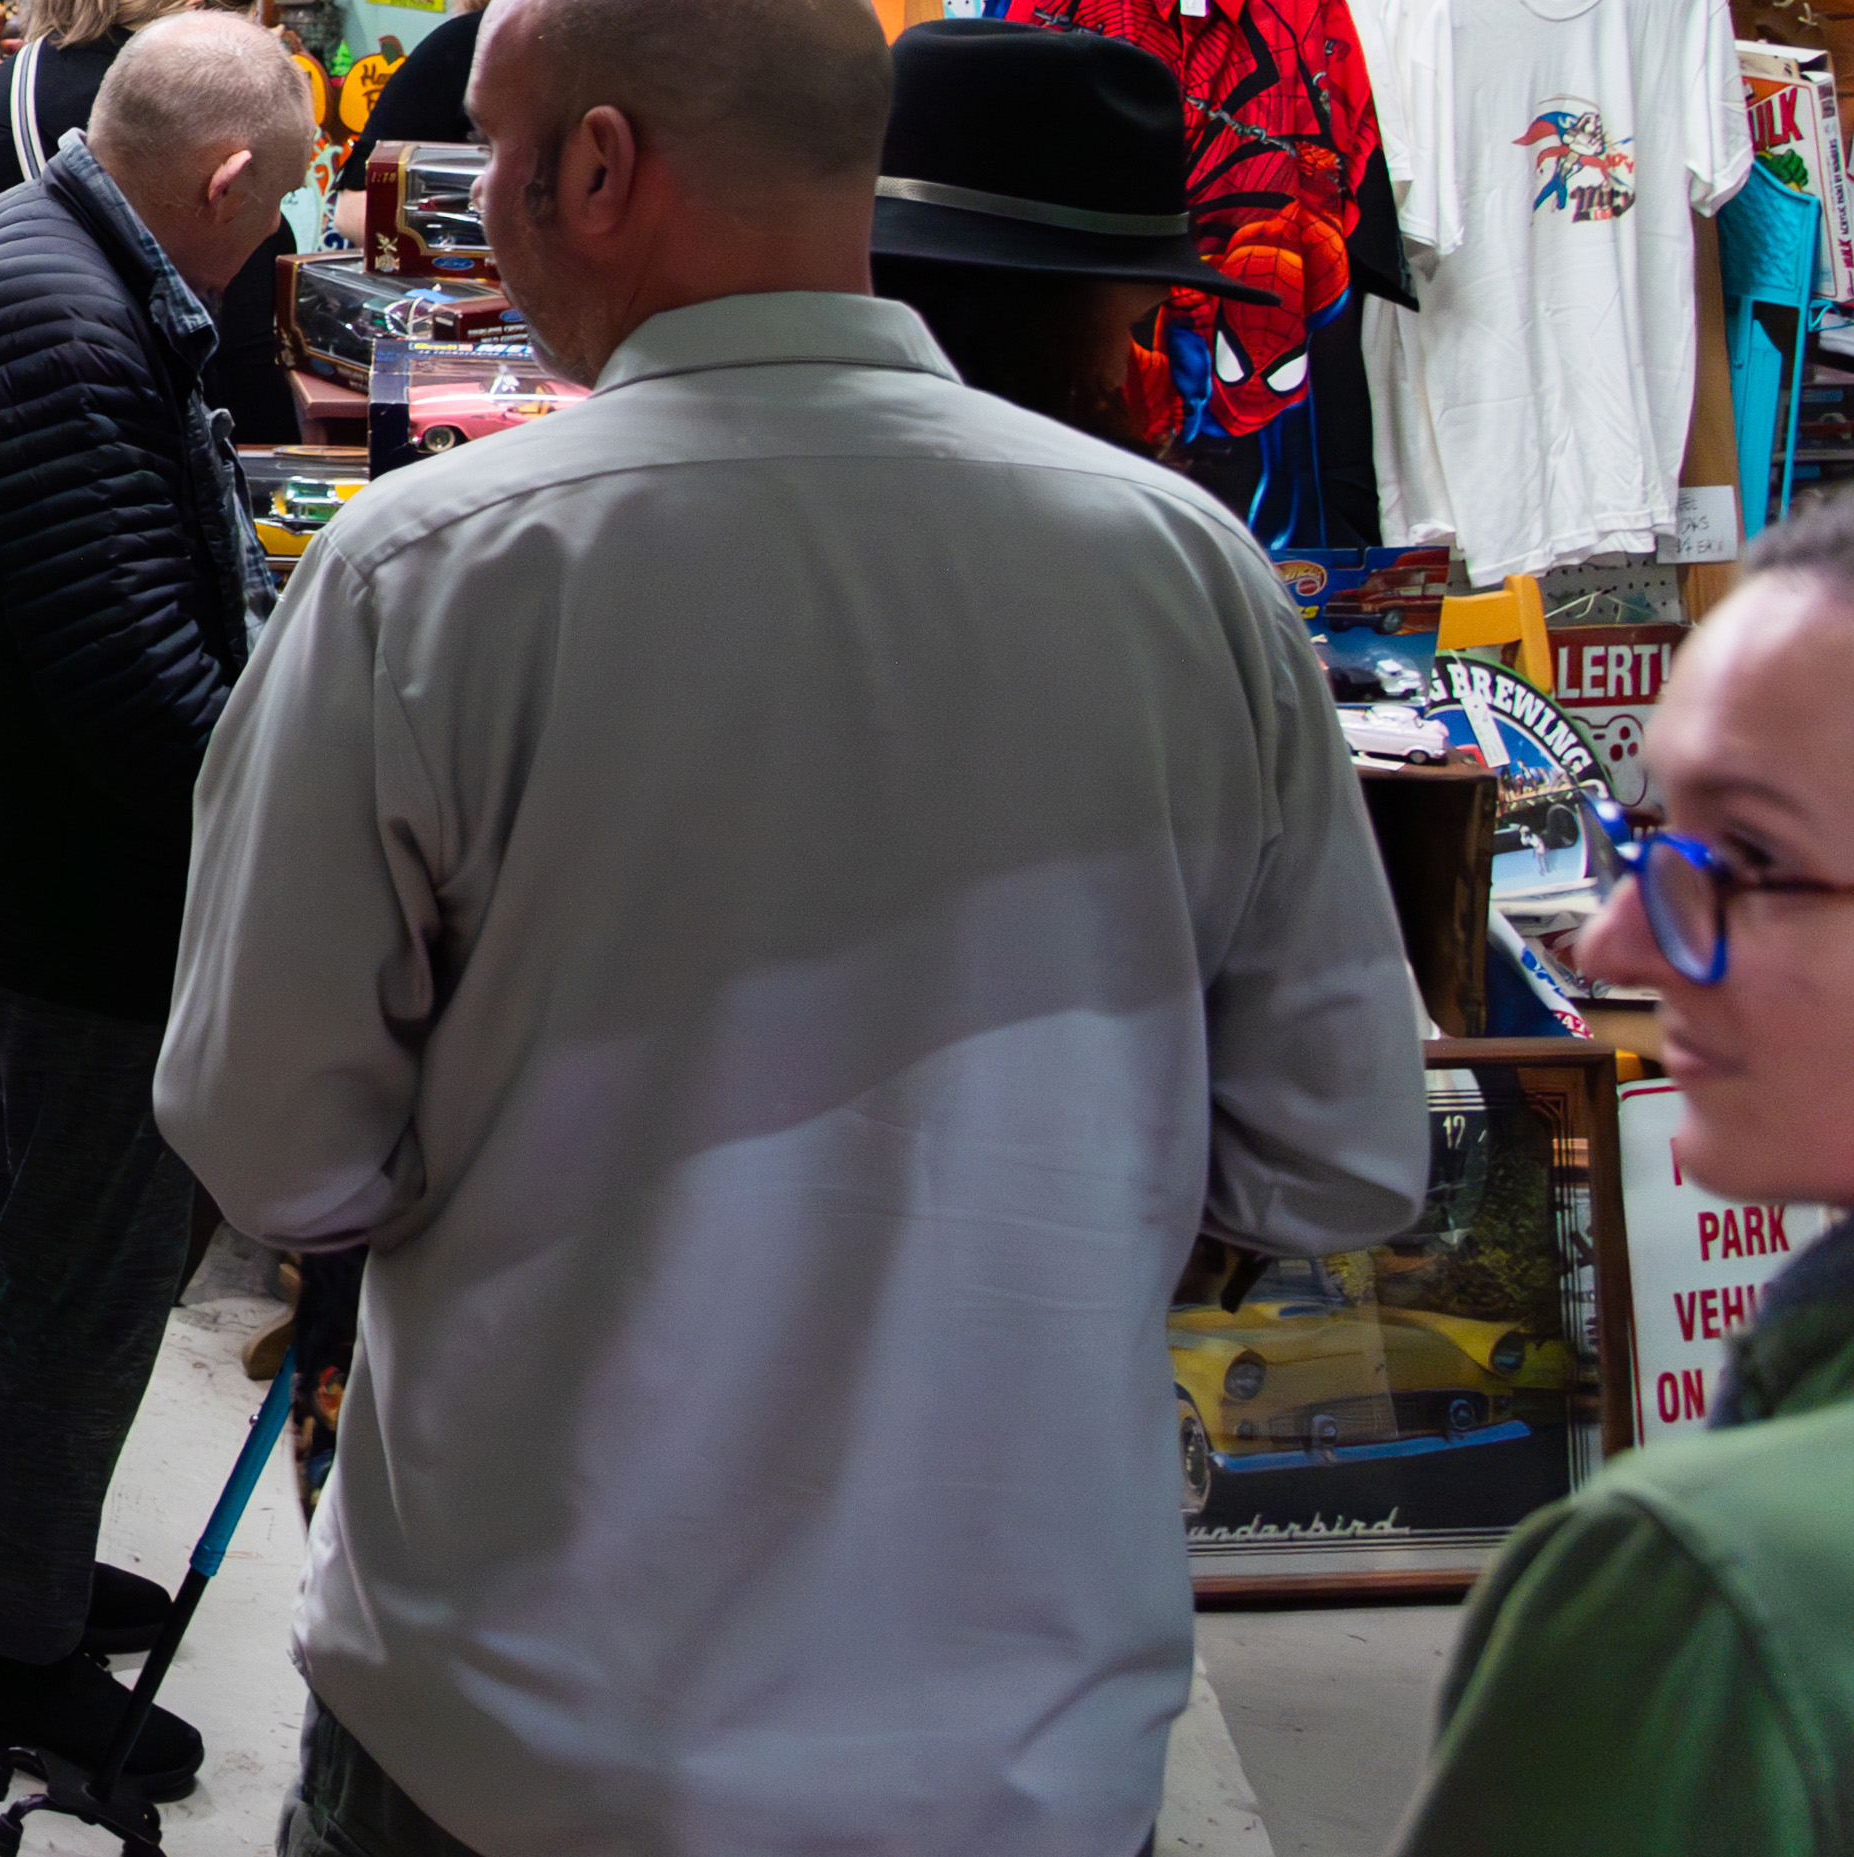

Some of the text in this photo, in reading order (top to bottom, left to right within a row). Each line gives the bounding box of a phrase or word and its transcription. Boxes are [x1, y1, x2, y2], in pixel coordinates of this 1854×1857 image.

[1750, 87, 1804, 152] ULK
[437, 257, 470, 269] Ford
[1554, 643, 1672, 701] LERT!
[1446, 663, 1594, 774] BREWING
[1698, 1205, 1790, 1262] PARK
[1673, 1283, 1764, 1345] VEHI
[1657, 1368, 1706, 1424] ON
[1187, 1507, 1404, 1541] underbird
